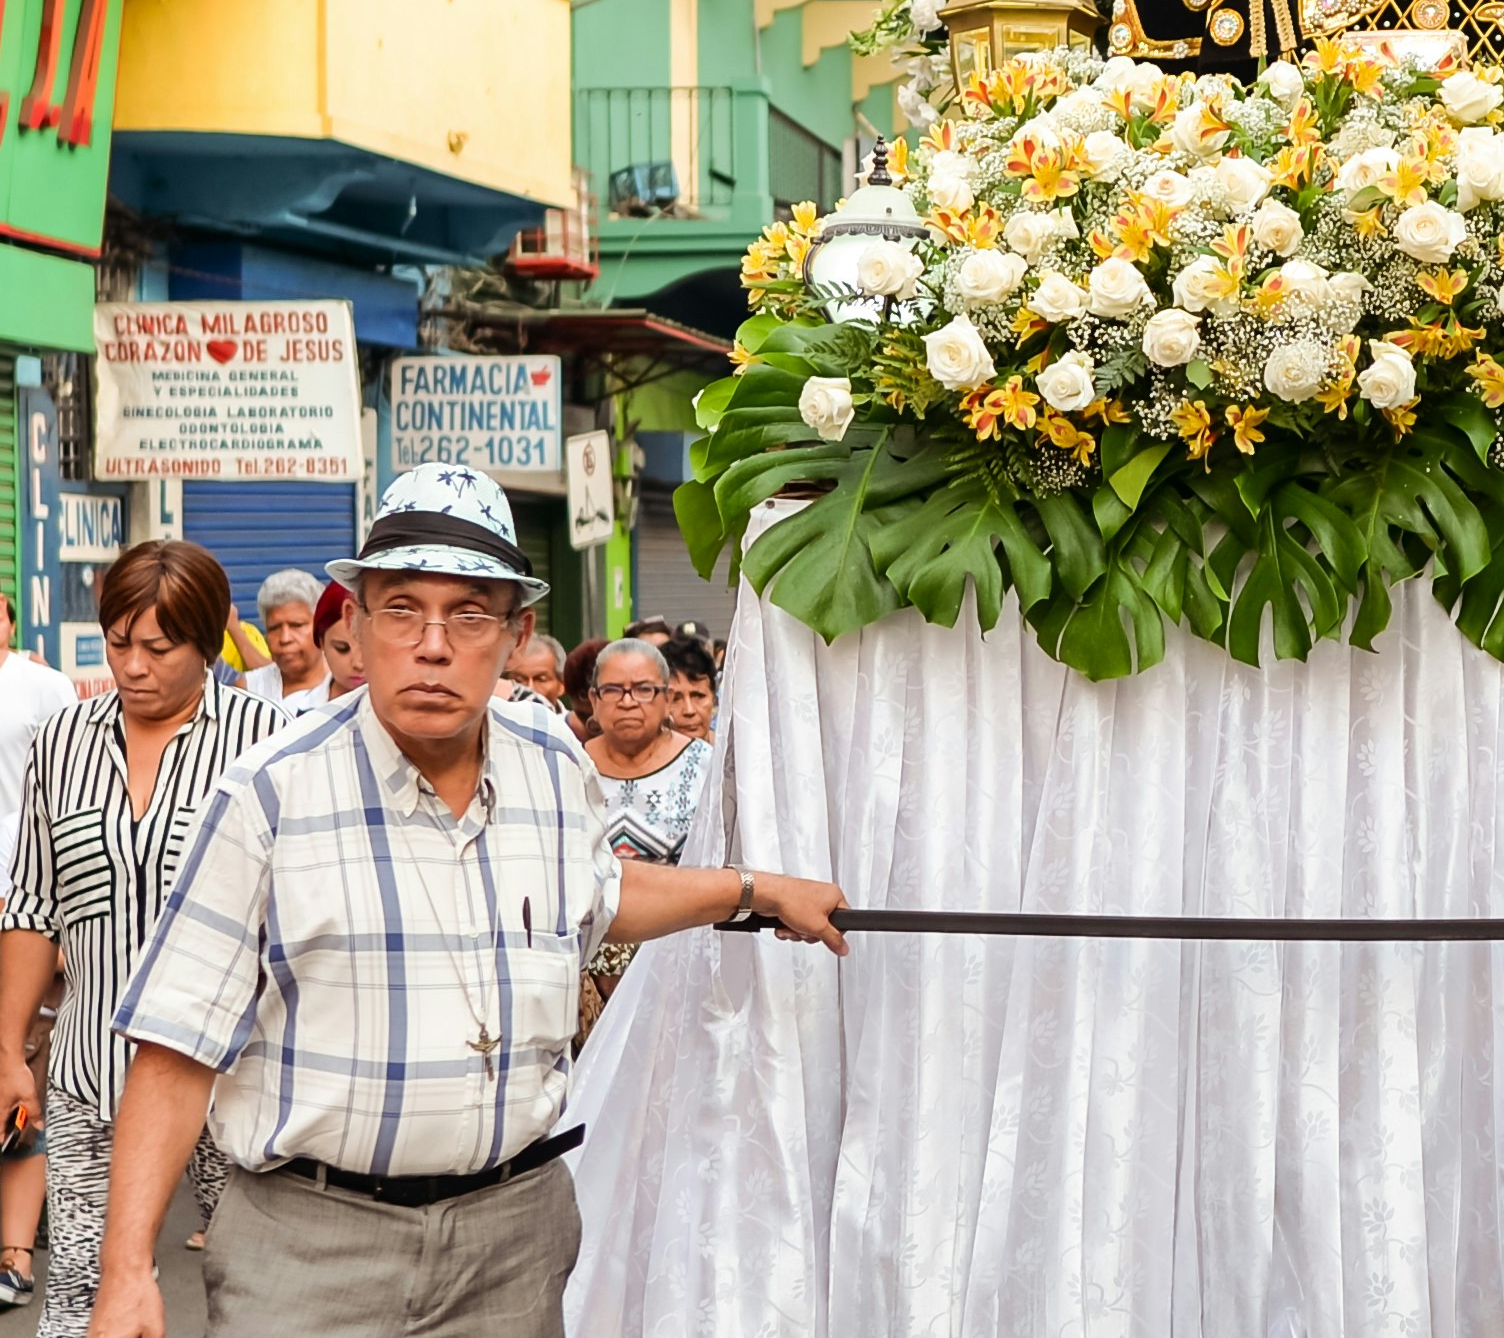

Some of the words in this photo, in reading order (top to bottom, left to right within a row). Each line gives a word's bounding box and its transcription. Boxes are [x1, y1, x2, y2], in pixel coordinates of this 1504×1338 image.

[114, 312, 188, 335] CLINICA
[201, 311, 329, 335] MILAGROSO
[105, 339, 202, 362] CORAZON
[243, 340, 268, 362] DE
[280, 339, 344, 362] JESUS
[152, 370, 220, 381] MEDICINA
[229, 370, 299, 381] GENERAL
[401, 363, 531, 395] FARMACIA
[169, 386, 299, 397] ESPECIALIDADES
[123, 405, 217, 418] GINECOLOGIA
[227, 405, 334, 418] LABORATORIO
[396, 400, 556, 432] CONTINENTAL
[179, 422, 284, 434] ODONTOLOGIA
[139, 437, 324, 450] ELECTROCARDIOGRAMA
[105, 457, 221, 475] ULTRASONIDO
